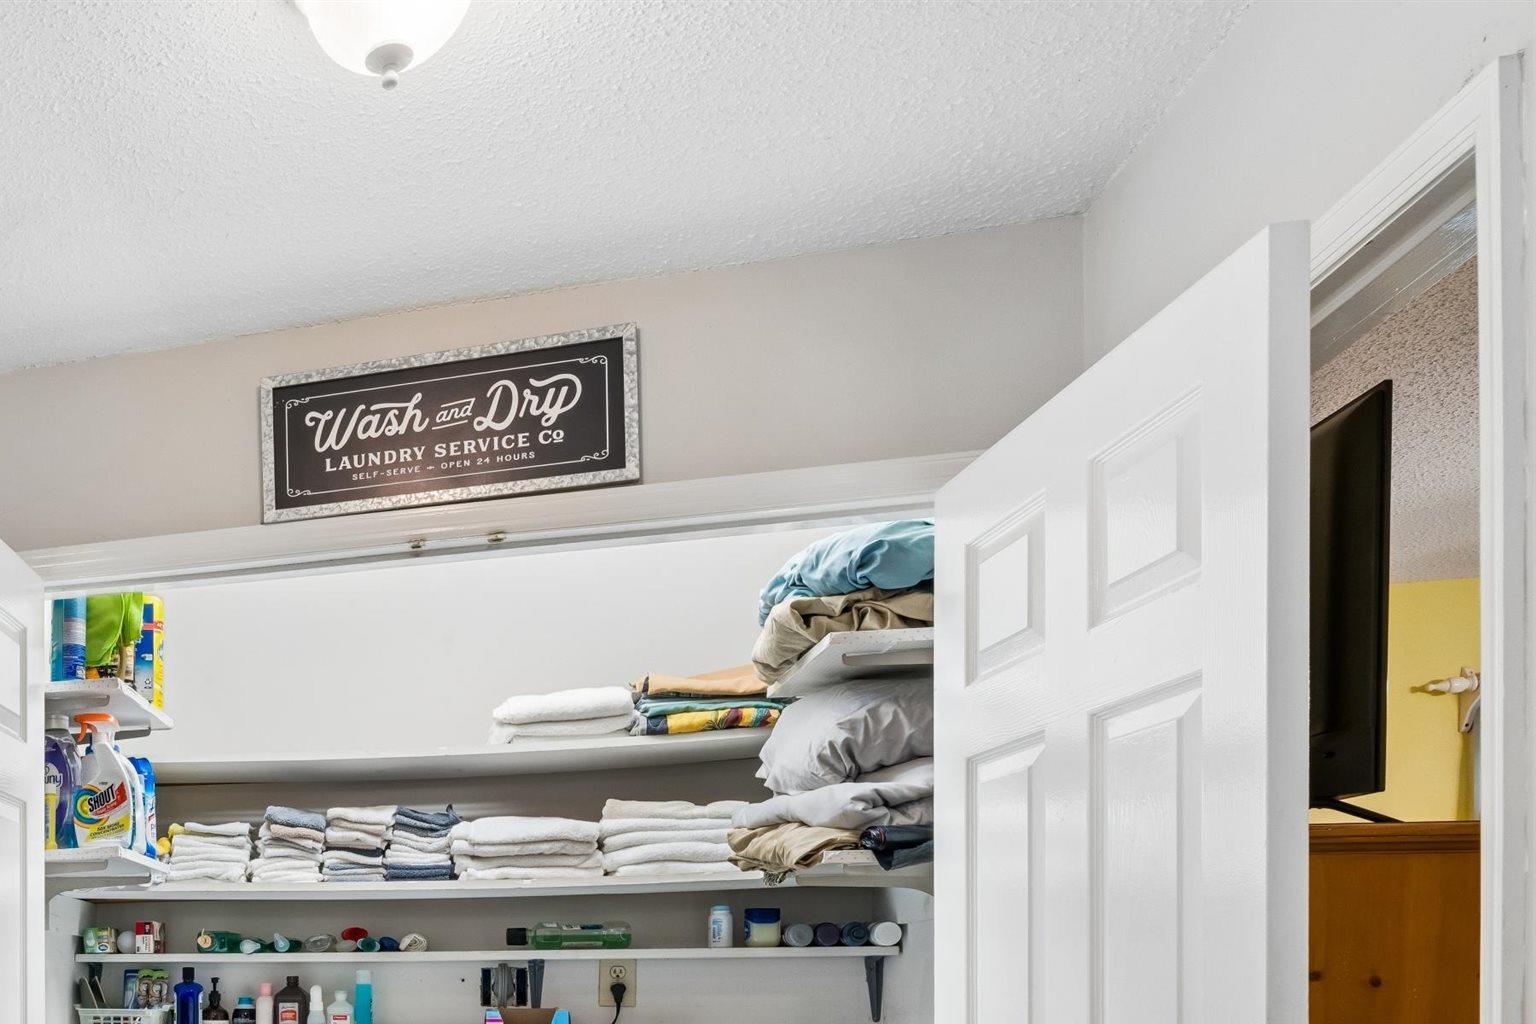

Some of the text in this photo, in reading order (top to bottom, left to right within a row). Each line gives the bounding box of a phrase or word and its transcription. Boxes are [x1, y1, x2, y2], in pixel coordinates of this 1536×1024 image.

[305, 373, 582, 453] Wash and Dry
[324, 446, 426, 473] LAUNDRY
[434, 432, 530, 458] SERVICE
[351, 450, 536, 481] SELF-SERVE OPEN 24 HOURS
[88, 783, 116, 813] SHOUT
